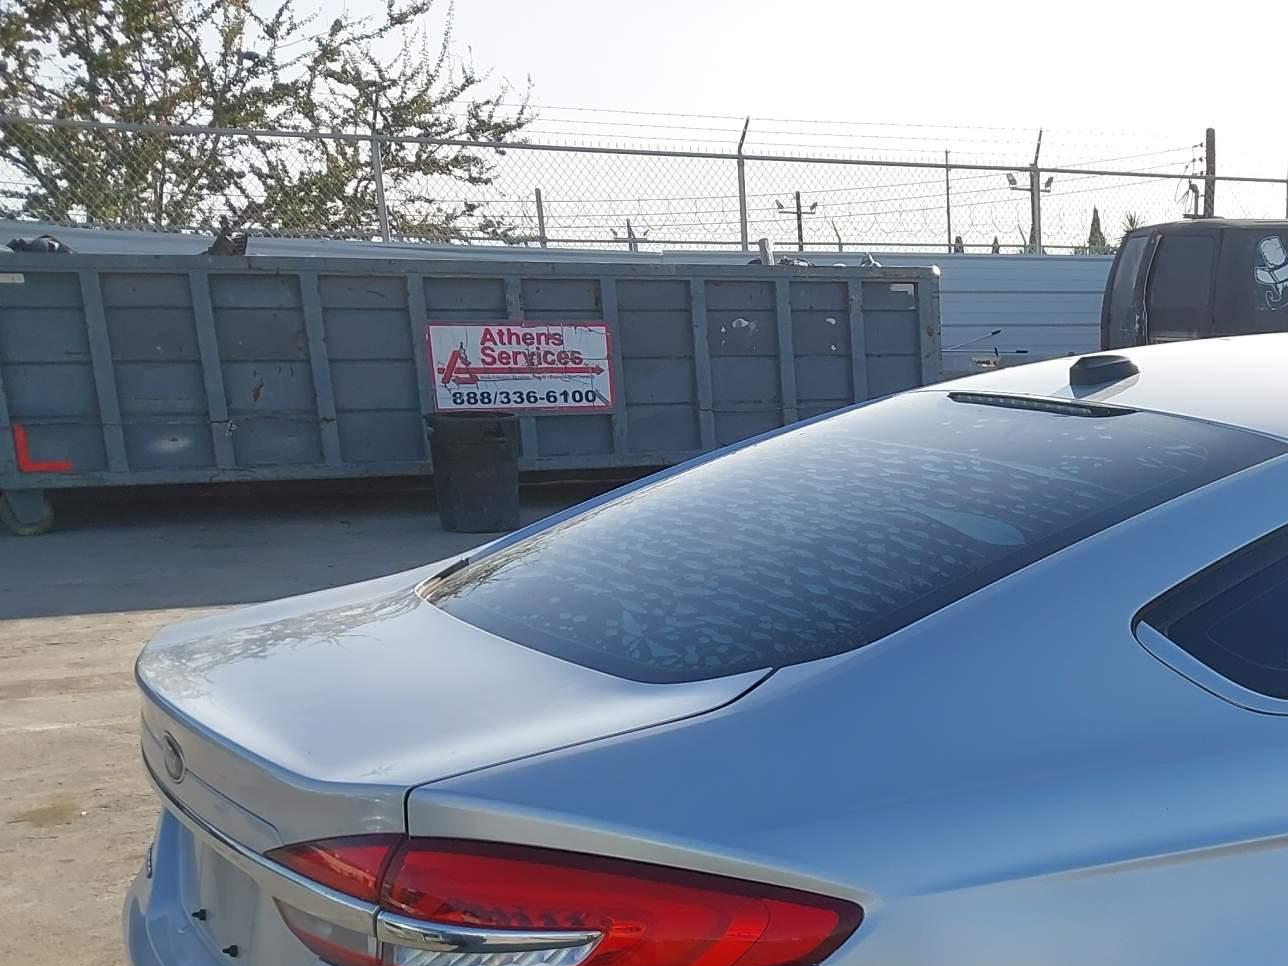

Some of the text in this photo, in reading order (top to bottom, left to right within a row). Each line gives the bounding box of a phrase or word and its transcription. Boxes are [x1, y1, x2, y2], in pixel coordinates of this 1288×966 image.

[480, 328, 563, 347] Athens
[481, 346, 584, 366] Services
[452, 389, 597, 405] 888/336-6100
